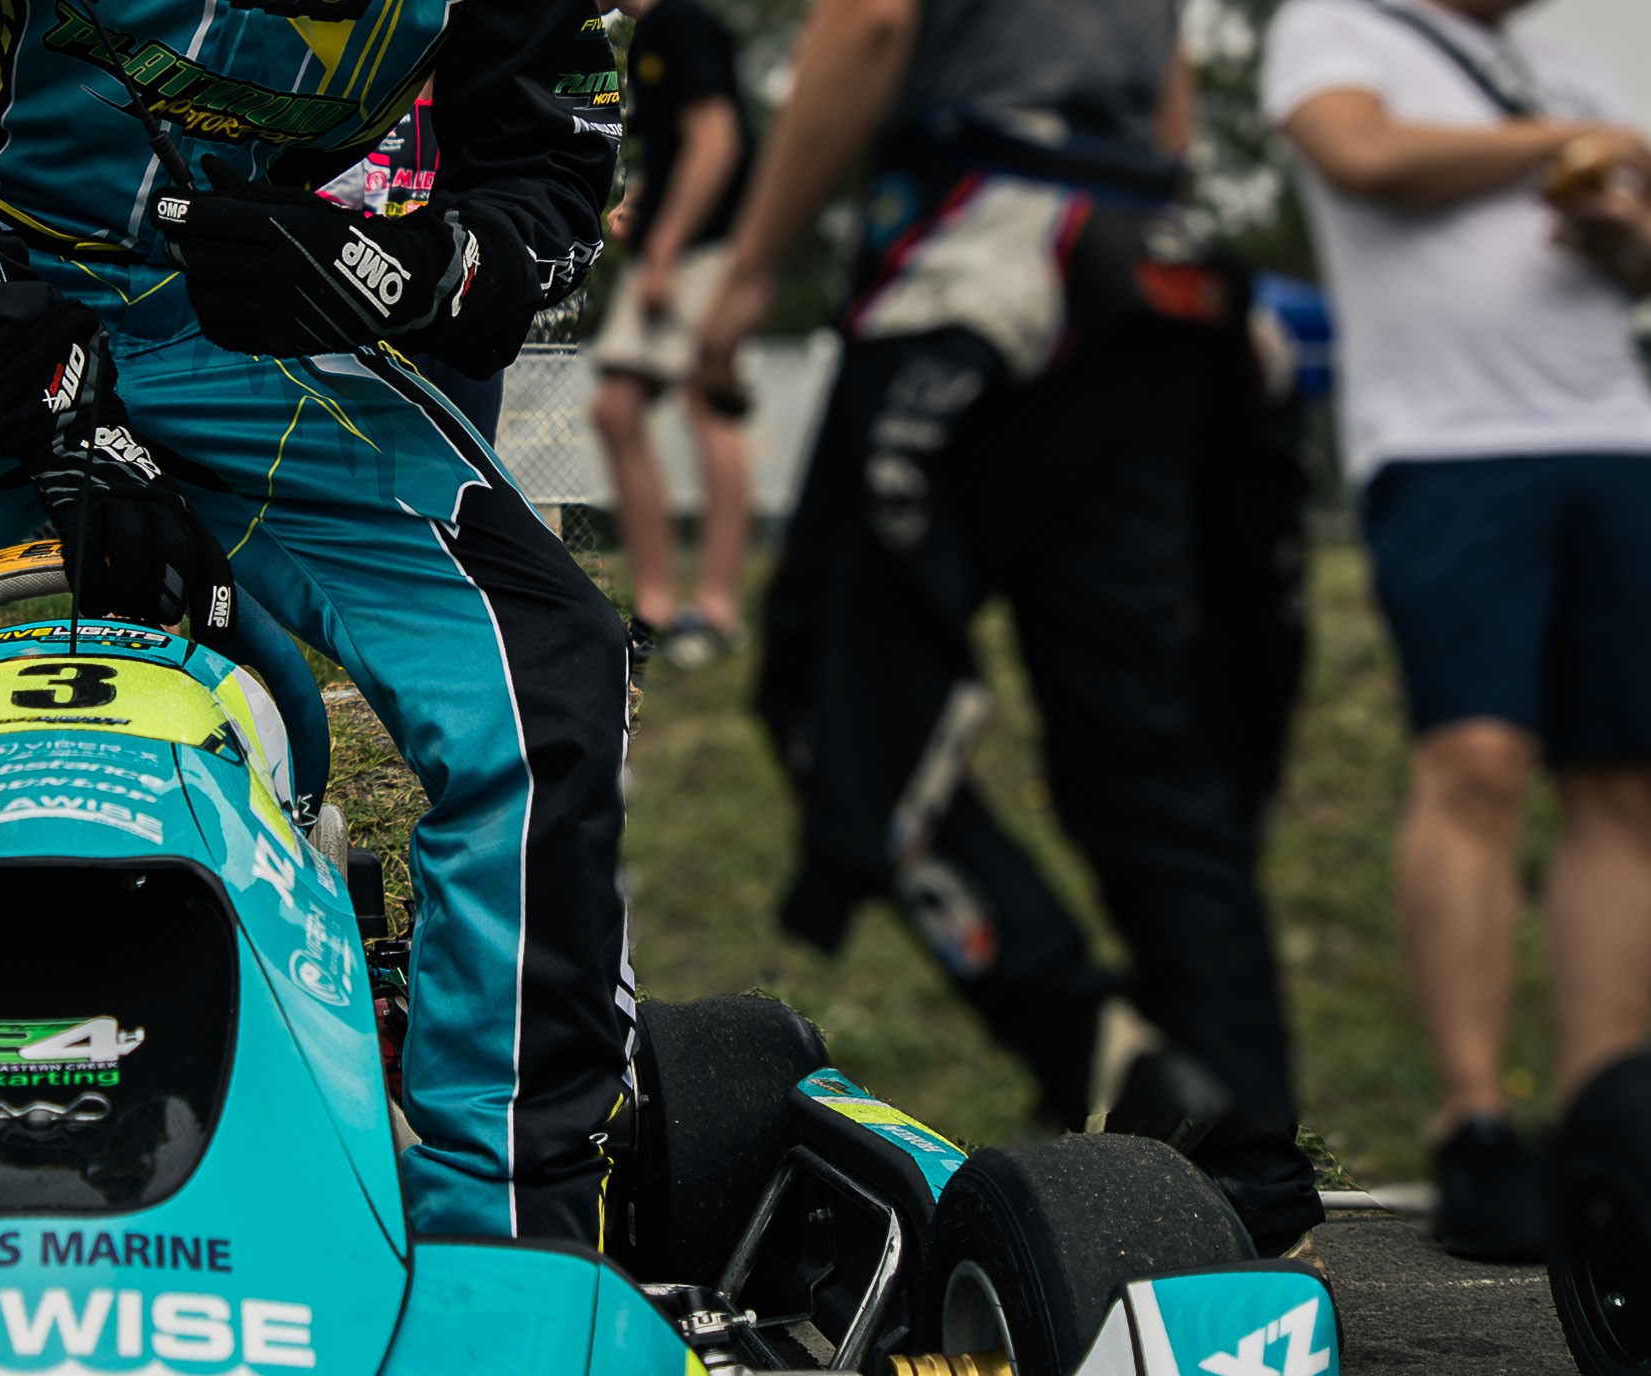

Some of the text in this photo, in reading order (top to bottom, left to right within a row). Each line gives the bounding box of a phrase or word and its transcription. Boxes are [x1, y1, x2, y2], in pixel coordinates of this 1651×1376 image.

[157, 200, 189, 220] OMP
[340, 238, 407, 308] OMP
[213, 585, 231, 628] OMP
[11, 662, 118, 710] 3
[65, 1060, 119, 1072] CREEK
[39, 1230, 234, 1274] MARINE
